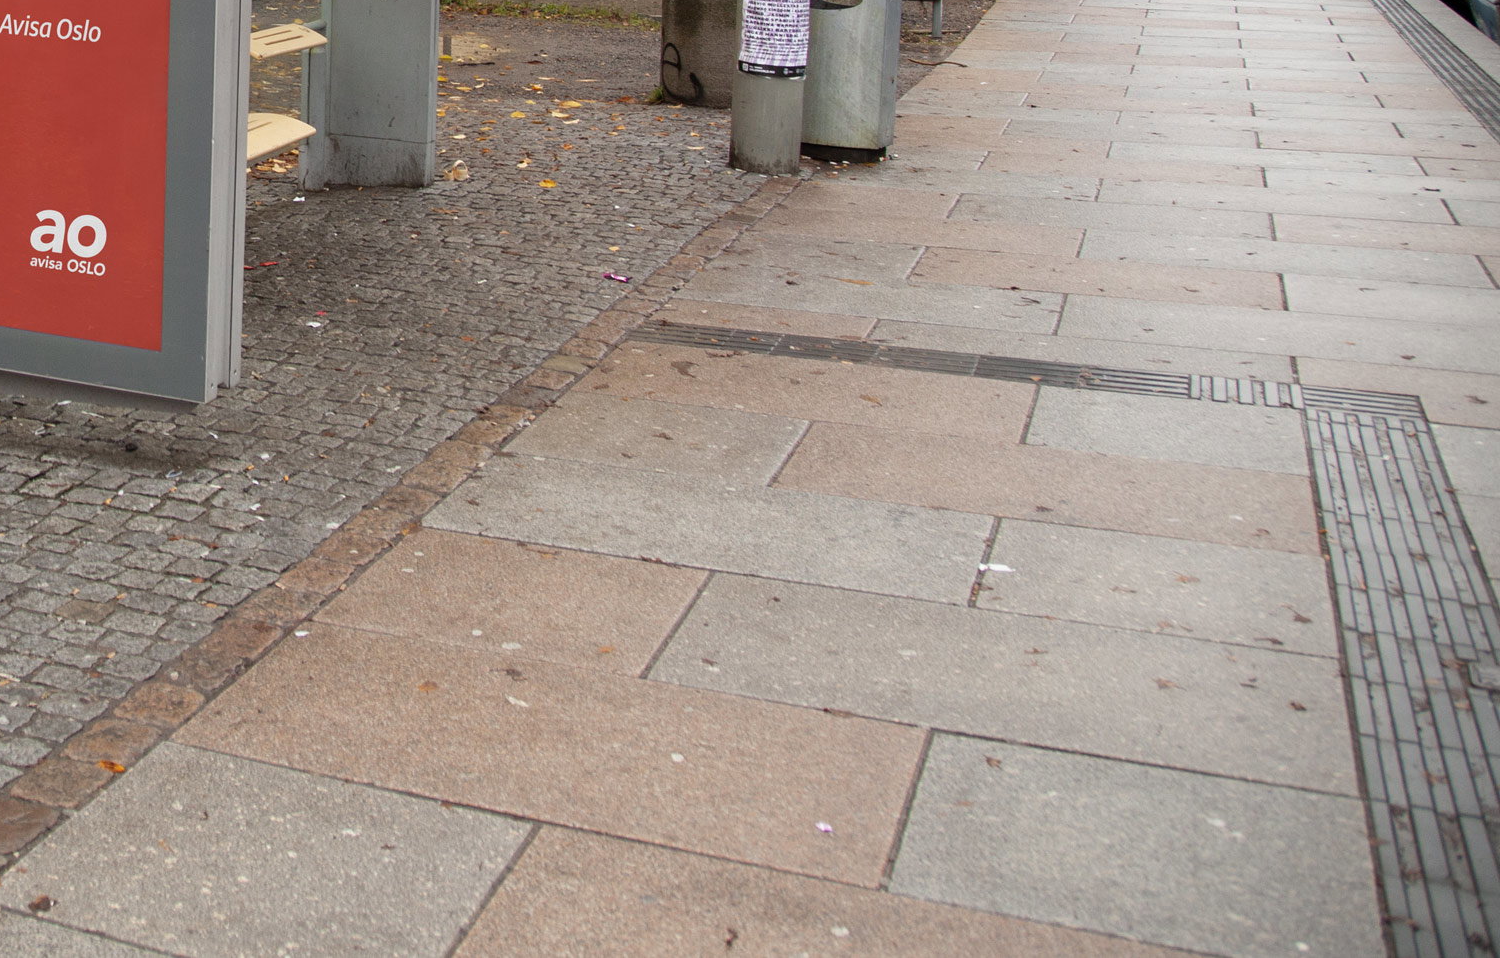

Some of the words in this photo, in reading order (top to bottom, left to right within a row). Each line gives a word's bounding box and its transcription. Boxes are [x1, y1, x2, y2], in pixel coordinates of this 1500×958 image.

[56, 18, 102, 43] Oslo
[29, 209, 108, 258] ao
[29, 255, 63, 271] avisa
[66, 258, 106, 277] OSLO
